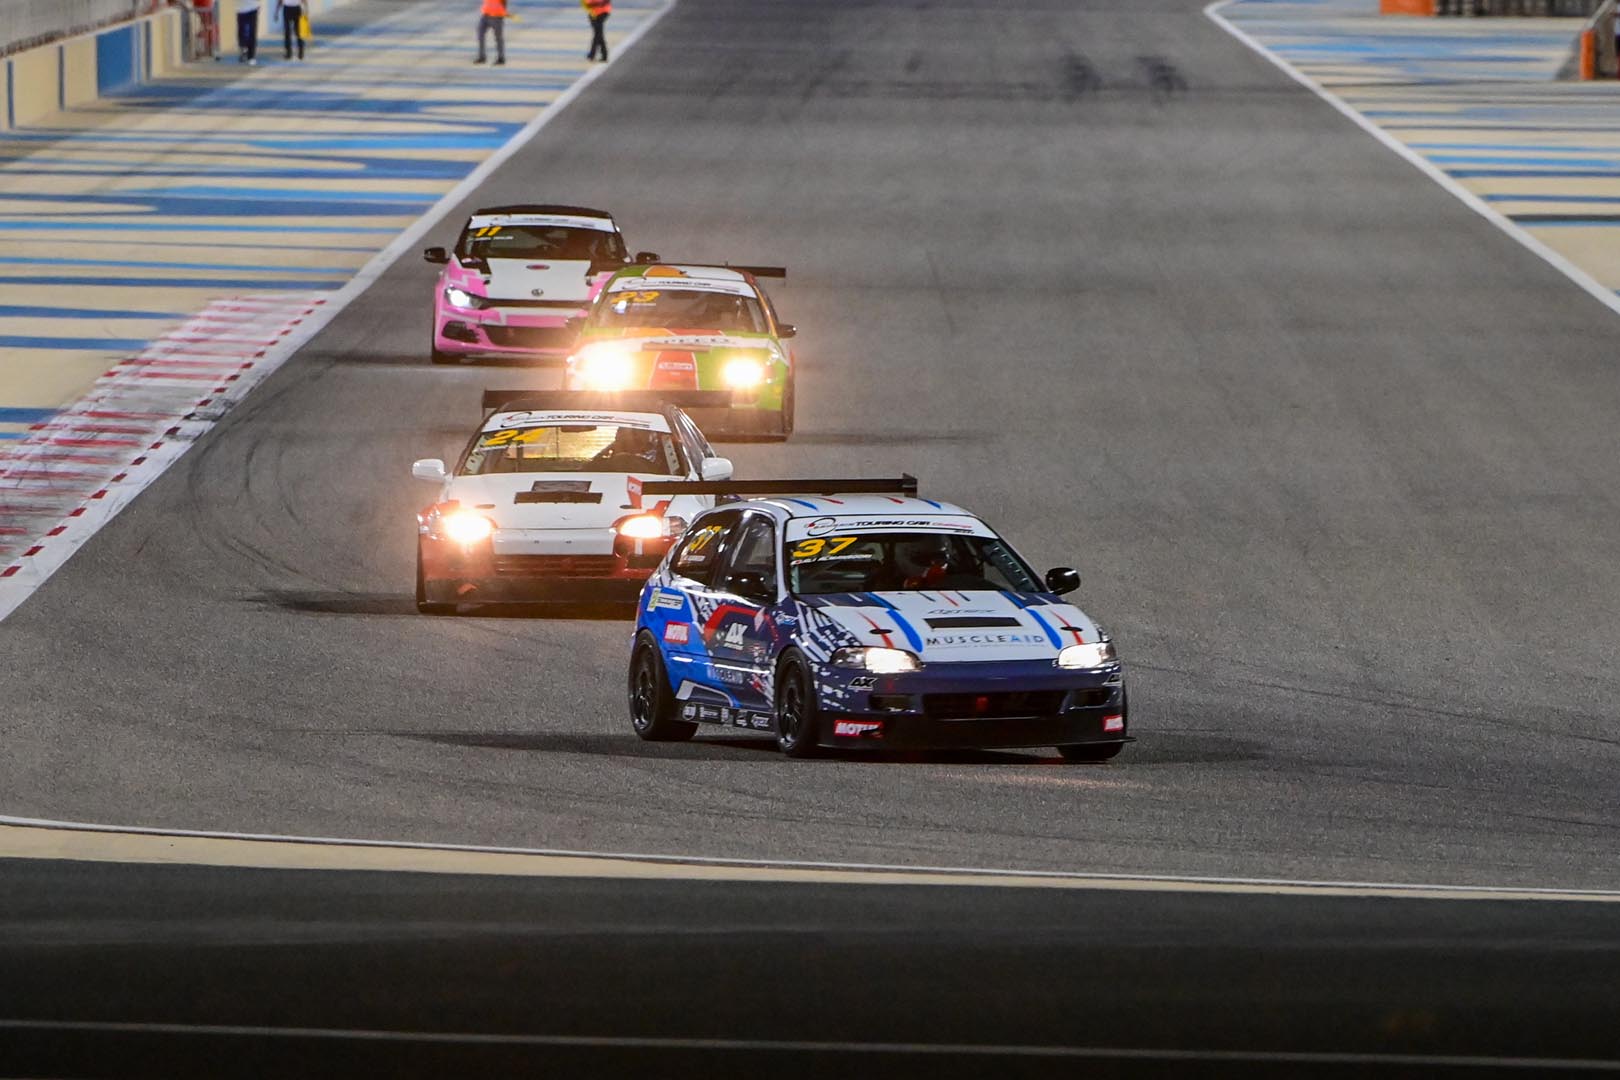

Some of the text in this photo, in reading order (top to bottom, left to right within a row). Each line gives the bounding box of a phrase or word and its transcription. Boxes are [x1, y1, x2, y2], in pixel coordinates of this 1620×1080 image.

[476, 226, 502, 237] 11
[792, 536, 858, 558] 37
[926, 634, 1045, 646] MUSCLEAID
